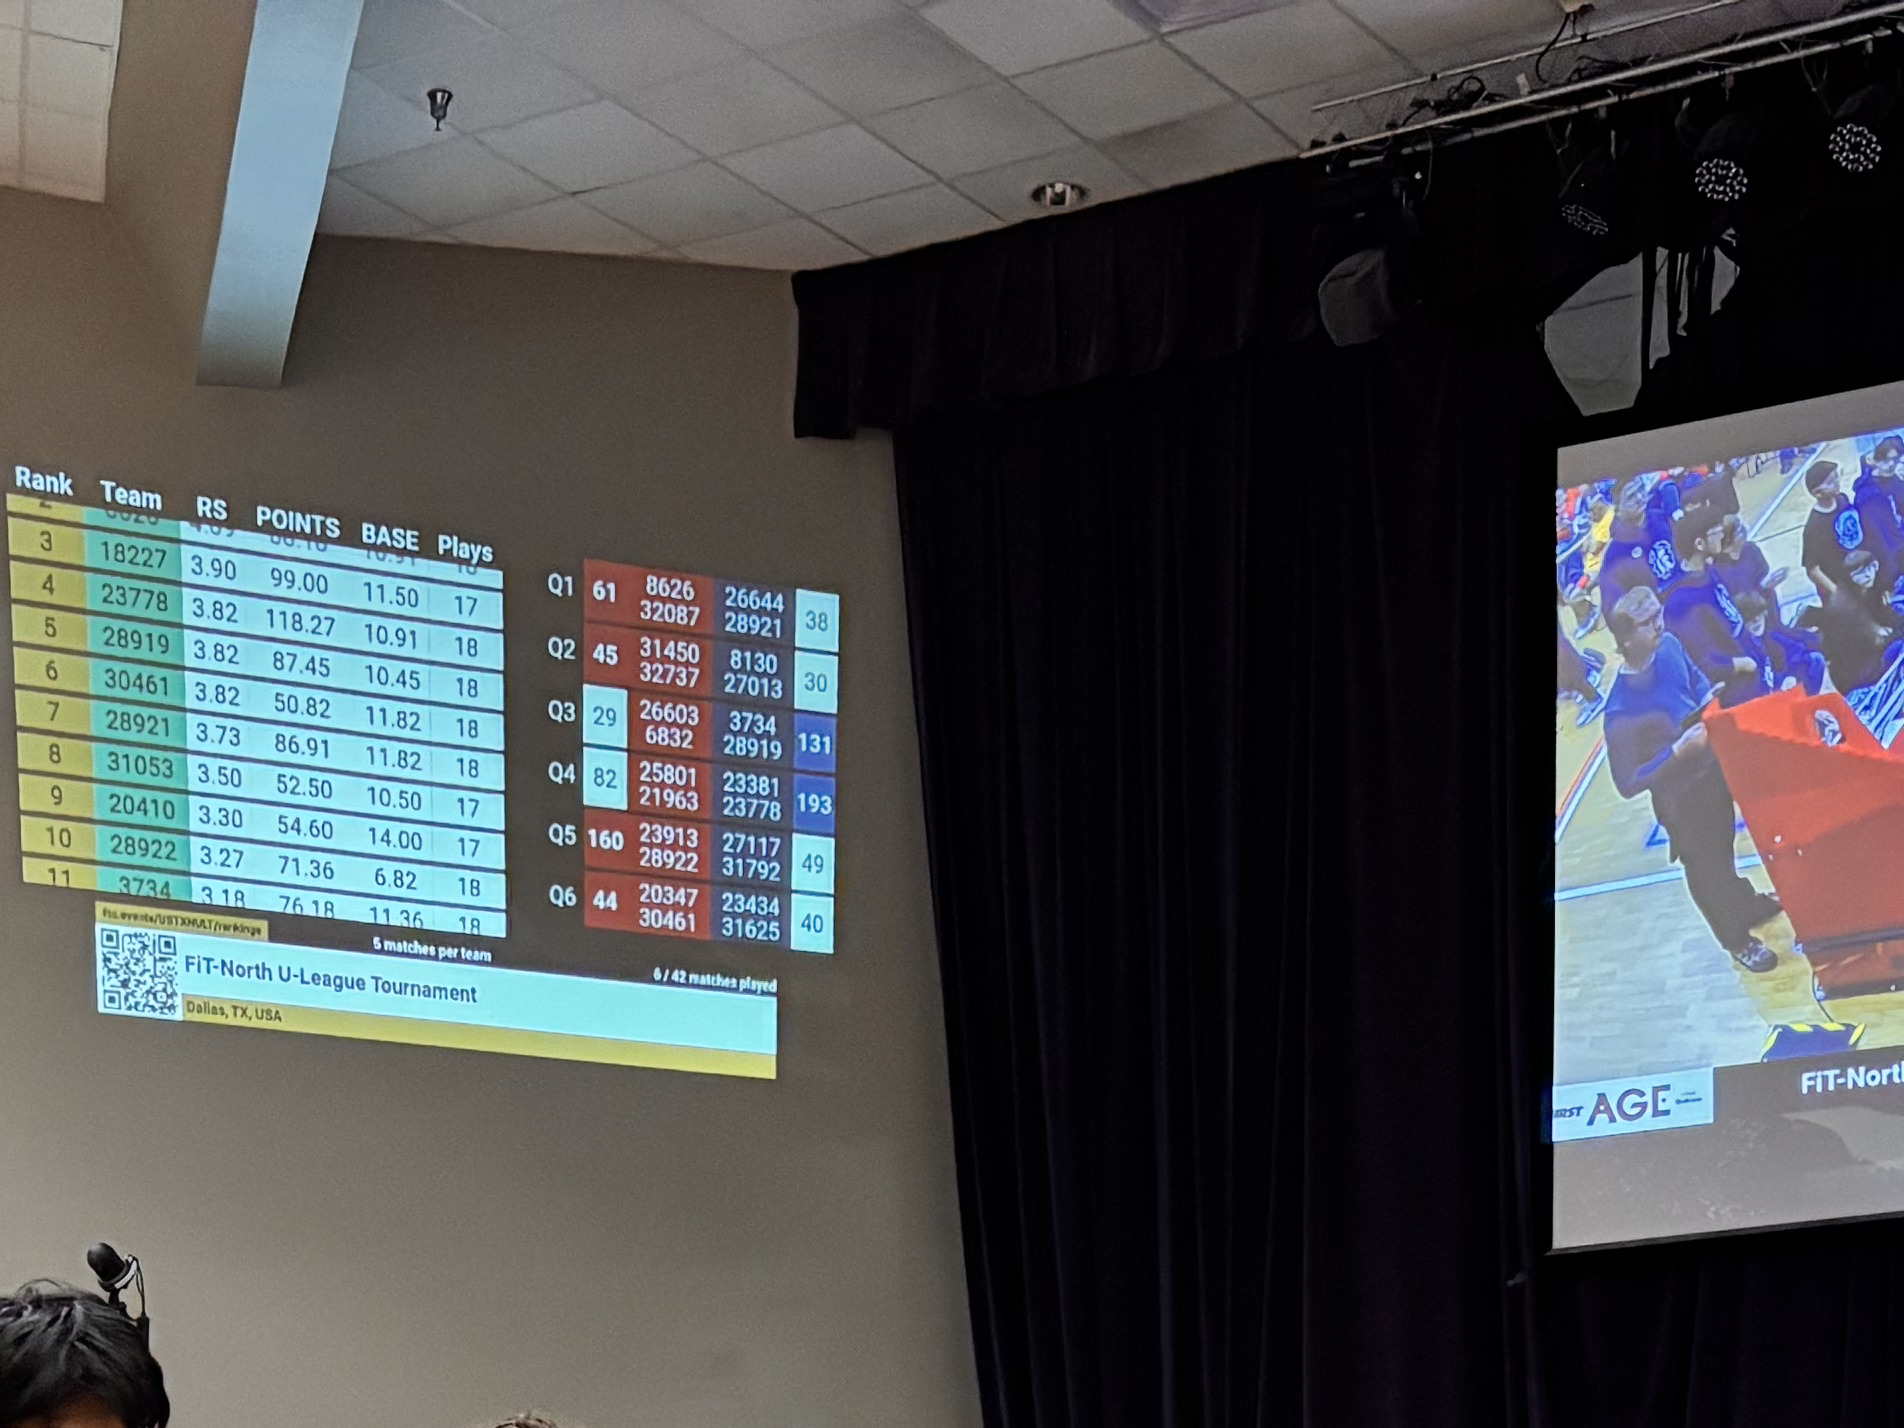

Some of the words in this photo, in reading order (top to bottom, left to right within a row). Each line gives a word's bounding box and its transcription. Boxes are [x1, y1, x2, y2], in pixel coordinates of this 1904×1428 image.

[15, 467, 73, 497] Rank
[101, 480, 162, 511] Team
[197, 497, 228, 520] RS
[257, 506, 341, 539] POINTS
[362, 523, 420, 551] BASE
[438, 535, 494, 564] Plays
[40, 532, 53, 552] 3
[101, 540, 167, 570] 18227
[191, 556, 237, 581] 3.90
[271, 568, 329, 594] 99.00
[363, 581, 420, 609] 11.50
[455, 596, 478, 617] 17
[41, 575, 55, 595] 4
[101, 583, 169, 613] 23778
[192, 598, 238, 623] 3.82
[266, 609, 336, 638] 118.27
[365, 622, 418, 650] 10.91
[455, 637, 478, 658] 18
[548, 573, 574, 598] Q1
[593, 580, 617, 602] 61
[646, 575, 695, 601] 8626
[725, 587, 785, 614] 26644
[805, 611, 829, 631] 38
[640, 601, 700, 627] 32087
[725, 613, 782, 639] 28921
[44, 618, 57, 638] 5
[102, 626, 170, 654] 28919
[193, 640, 240, 665] 3.82
[273, 652, 331, 678] 87.45
[366, 664, 421, 691] 10.45
[456, 678, 479, 698] 18
[548, 637, 576, 660] Q2
[593, 643, 619, 665] 45
[640, 637, 701, 664] 31450
[730, 650, 778, 673] 8130
[804, 672, 828, 693] 30
[640, 664, 701, 688] 32737
[724, 674, 784, 699] 27013
[45, 661, 59, 681] 6
[104, 668, 170, 697] 30461
[195, 682, 241, 707] 3.82
[274, 693, 331, 719] 50.82
[366, 705, 422, 731] 11.82
[456, 718, 479, 738] 18
[47, 703, 60, 722] 7
[106, 710, 171, 738] 28921
[196, 723, 241, 747] 3.73
[274, 733, 330, 760] 86.91
[367, 745, 422, 772] 11.82
[456, 758, 480, 778] 18
[548, 701, 576, 722] Q3
[593, 706, 617, 726] 29
[640, 700, 700, 726] 26603
[730, 711, 776, 736] 3734
[798, 733, 832, 755] 131
[646, 725, 694, 749] 6832
[723, 735, 783, 760] 28919
[48, 744, 62, 764] 8
[107, 752, 174, 779] 31053
[197, 764, 242, 788] 3.50
[276, 774, 333, 799] 52.50
[367, 785, 422, 811] 10.50
[457, 799, 480, 817] 17
[548, 762, 576, 785] Q4
[593, 768, 617, 788] 82
[640, 762, 697, 787] 25801
[723, 772, 780, 796] 23381
[798, 793, 833, 814] 193
[640, 787, 699, 811] 21963
[723, 796, 782, 822] 23778
[50, 785, 63, 805] 9
[109, 793, 175, 821] 20410
[198, 805, 243, 829] 3.30
[277, 815, 334, 840] 54.60
[368, 826, 423, 851] 14.00
[458, 838, 480, 858] 17
[47, 826, 72, 847] 10
[110, 834, 177, 861] 28922
[200, 845, 244, 870] 3.27
[278, 855, 334, 880] 71.36
[374, 868, 418, 890] 6.82
[458, 877, 481, 897] 18
[549, 824, 577, 847] Q5
[589, 828, 625, 850] 160
[639, 823, 699, 848] 23913
[723, 833, 781, 858] 27117
[803, 853, 825, 873] 49
[639, 847, 699, 872] 28922
[722, 856, 781, 882] 31792
[549, 885, 577, 908] Q6
[593, 891, 618, 911] 44
[639, 883, 699, 908] 20347
[722, 892, 780, 916] 23434
[801, 914, 824, 934] 40
[639, 908, 697, 932] 30461
[722, 916, 781, 941] 31625
[384, 939, 435, 958] matches
[439, 948, 458, 960] per
[461, 950, 492, 963] team
[653, 967, 662, 980] 6
[671, 969, 686, 983] 42
[185, 955, 273, 982] FiT-North
[278, 964, 366, 992] U-League
[371, 976, 477, 1003] Tournament
[186, 1001, 228, 1020] Dallas,
[231, 1006, 251, 1020] TX,
[255, 1008, 282, 1022] USA
[1587, 1084, 1670, 1126] AGE
